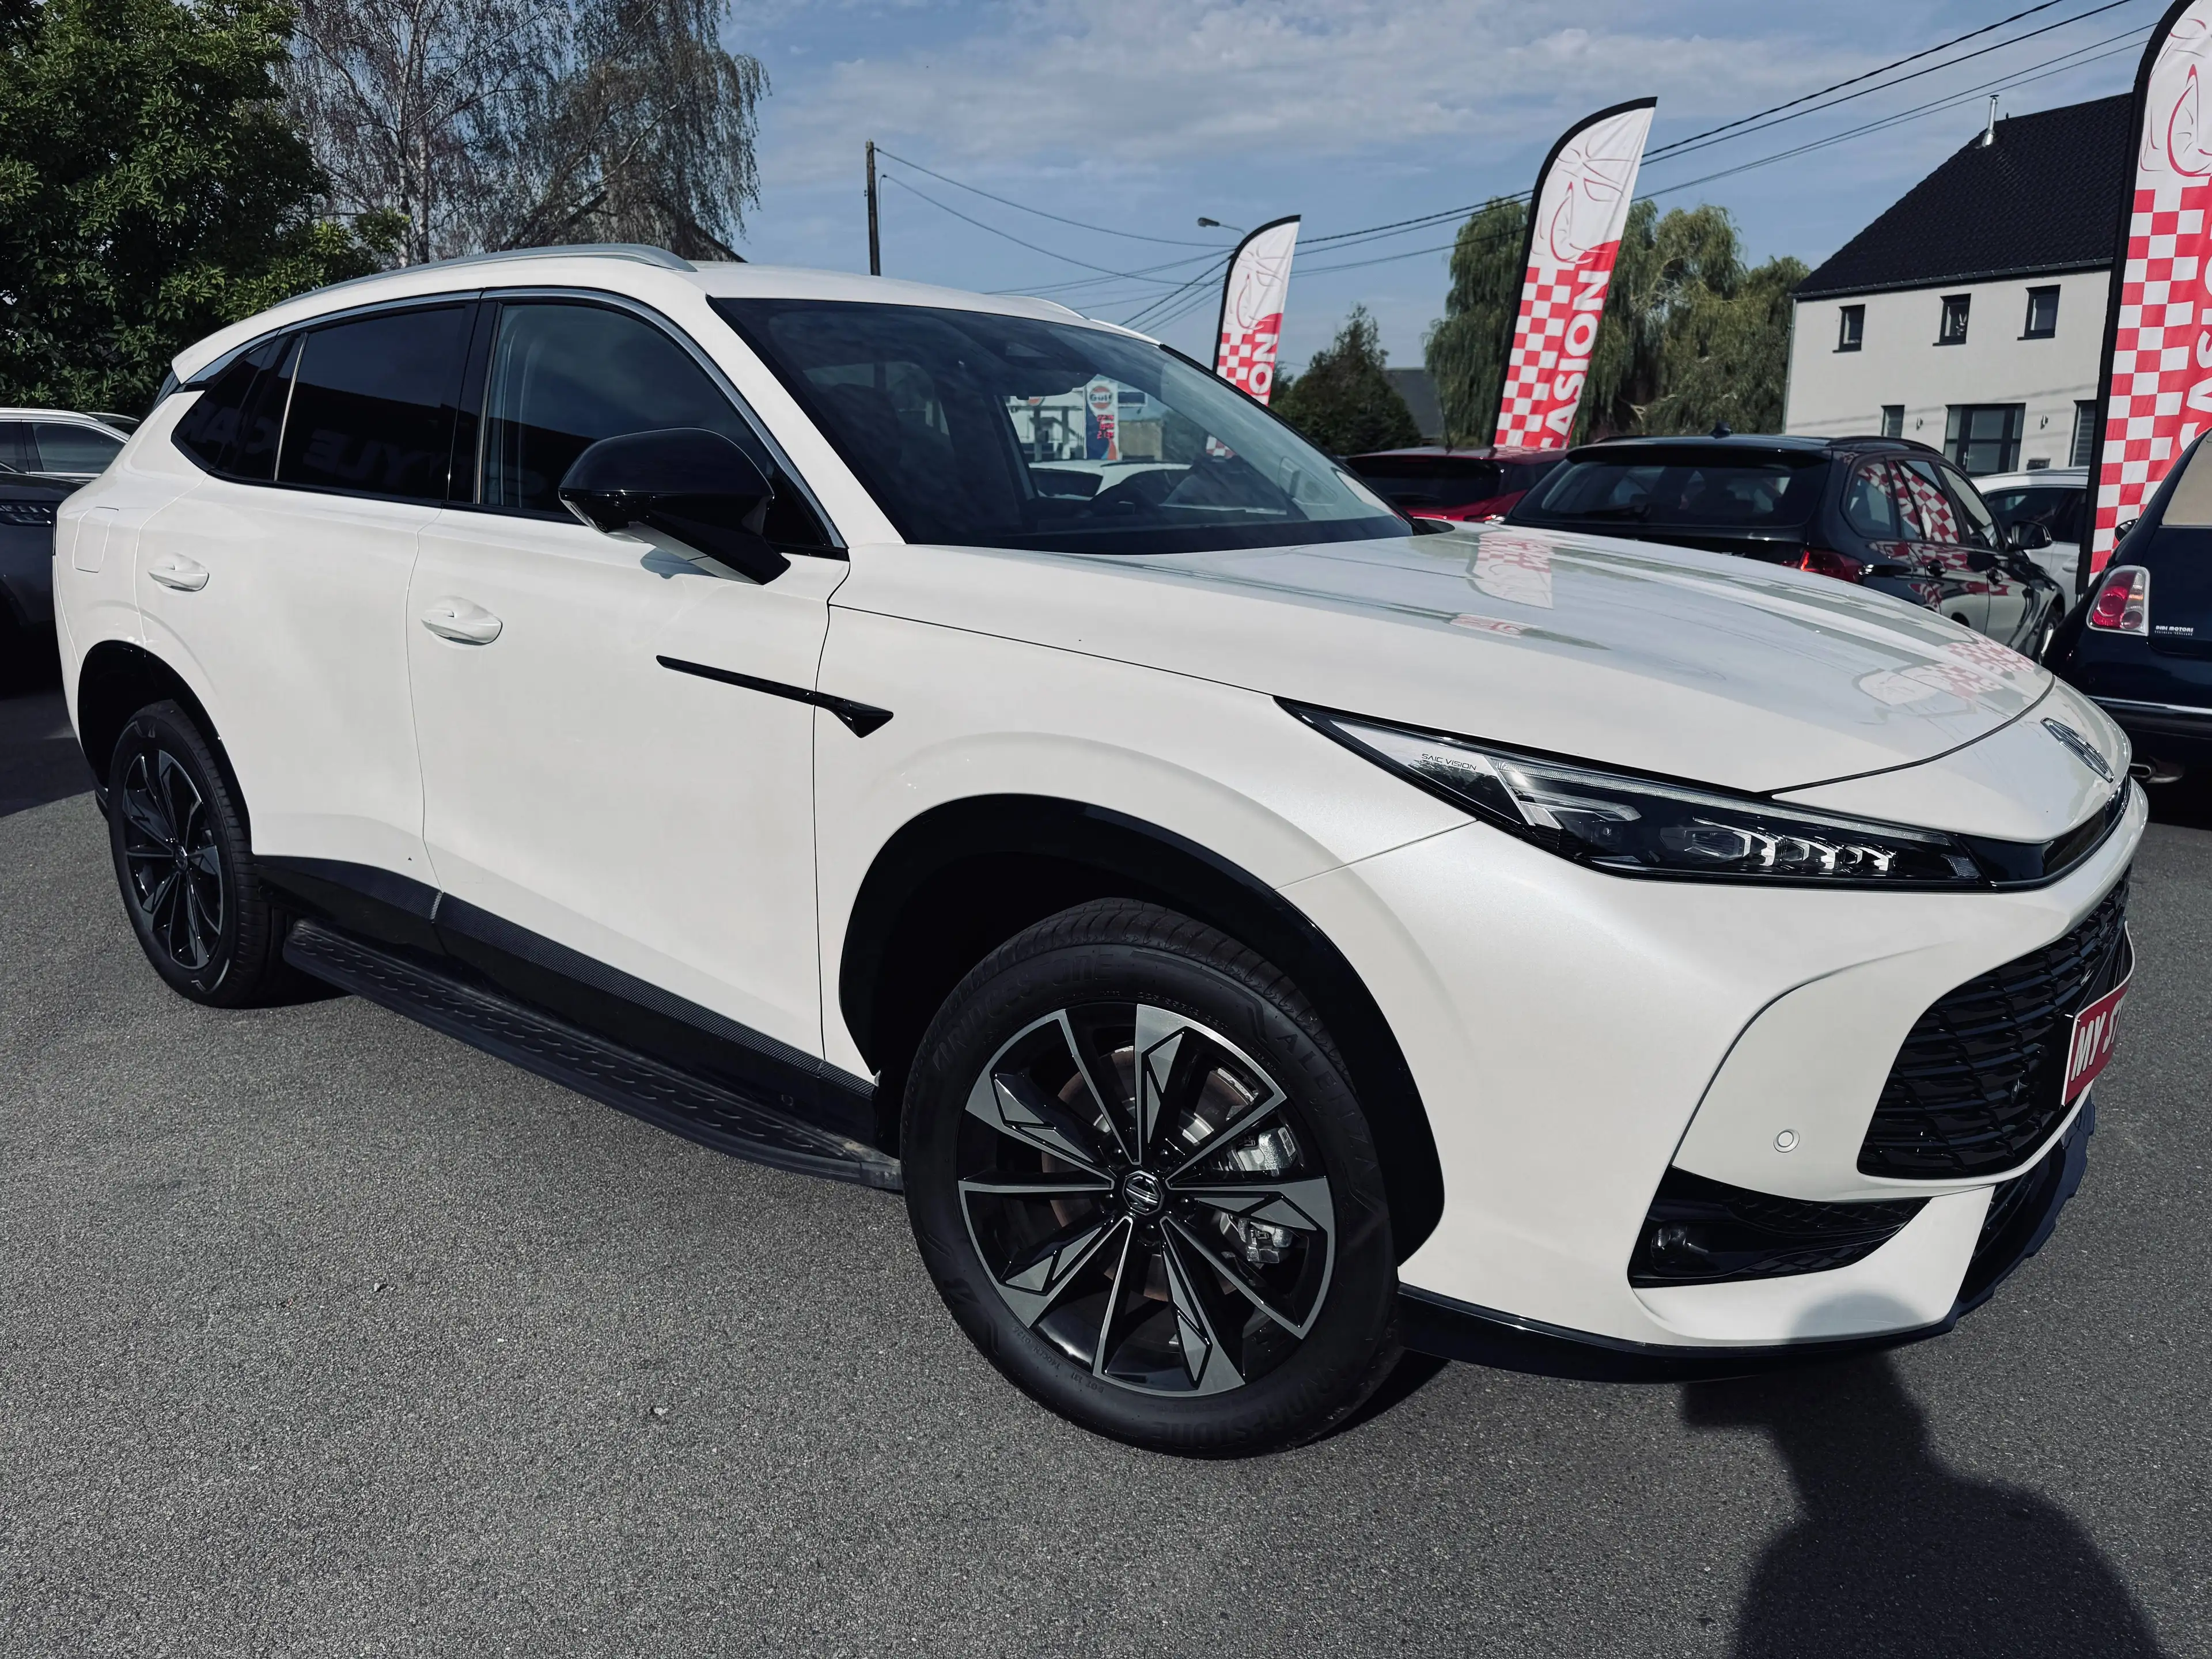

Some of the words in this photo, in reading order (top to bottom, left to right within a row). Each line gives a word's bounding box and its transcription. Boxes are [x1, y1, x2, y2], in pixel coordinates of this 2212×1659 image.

[1090, 394, 1112, 402] Gulf
[1422, 753, 1444, 763] SAIC
[1446, 759, 1477, 771] VISION
[2070, 1011, 2107, 1082] MY
[2102, 994, 2127, 1054] ST
